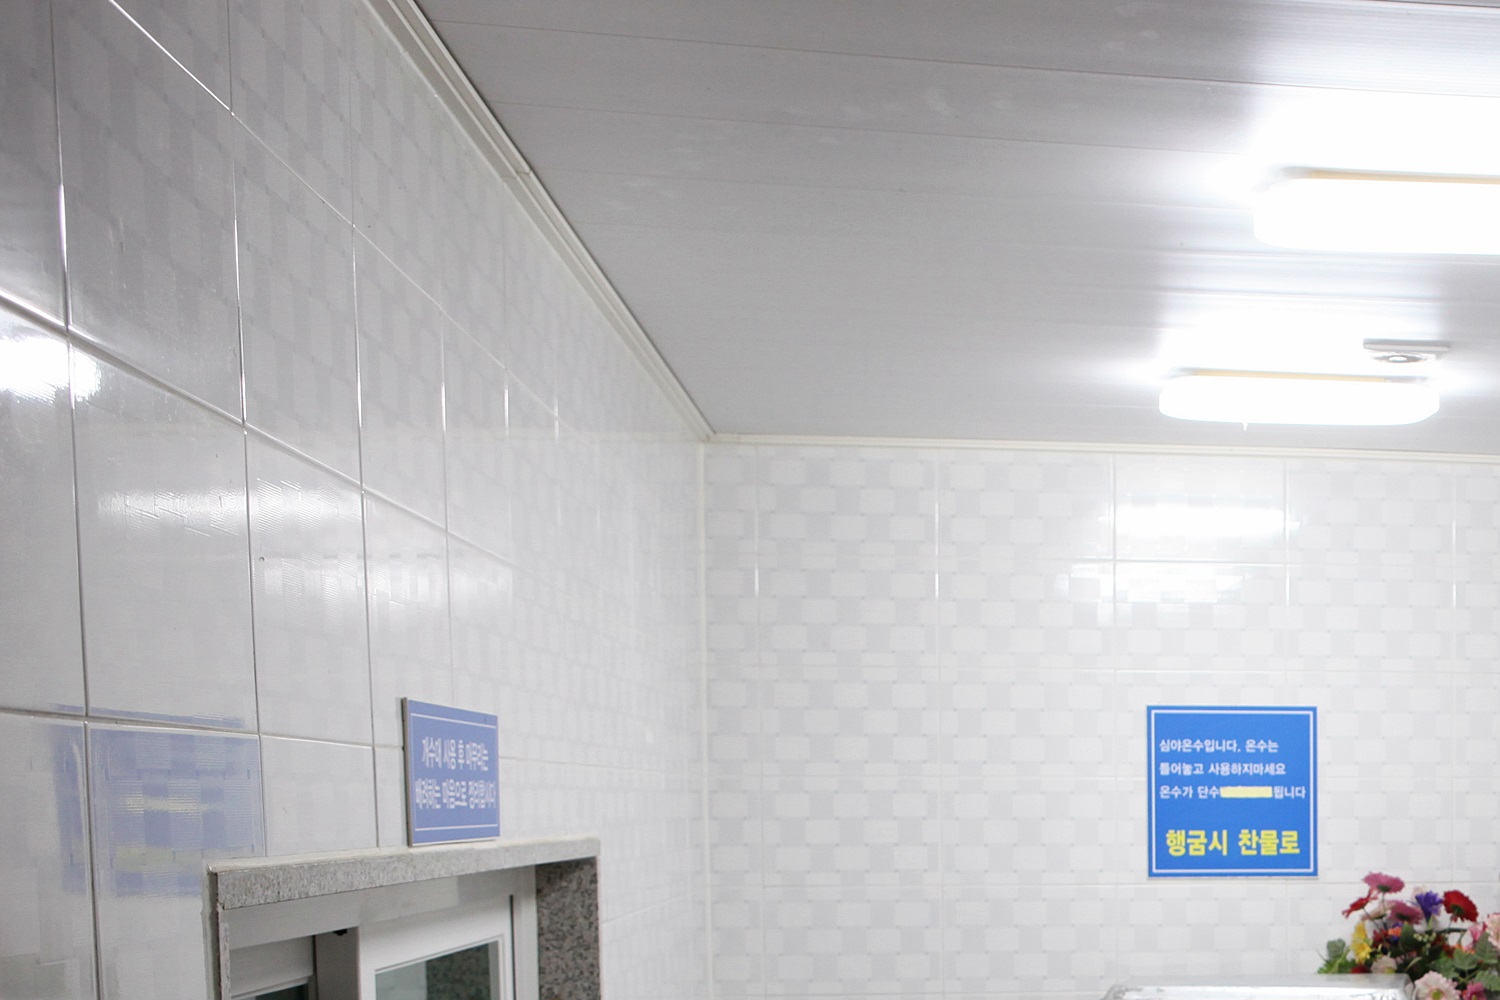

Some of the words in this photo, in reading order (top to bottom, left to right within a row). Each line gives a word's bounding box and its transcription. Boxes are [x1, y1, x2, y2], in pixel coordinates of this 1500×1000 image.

[1159, 739, 1241, 753] 심야온수입니다.
[1245, 739, 1279, 753] 온수는
[1159, 762, 1204, 776] 틀어놓고
[1208, 762, 1286, 776] 사용하지마세요
[1159, 786, 1193, 799] 온수가
[1238, 829, 1300, 856] 찬물로
